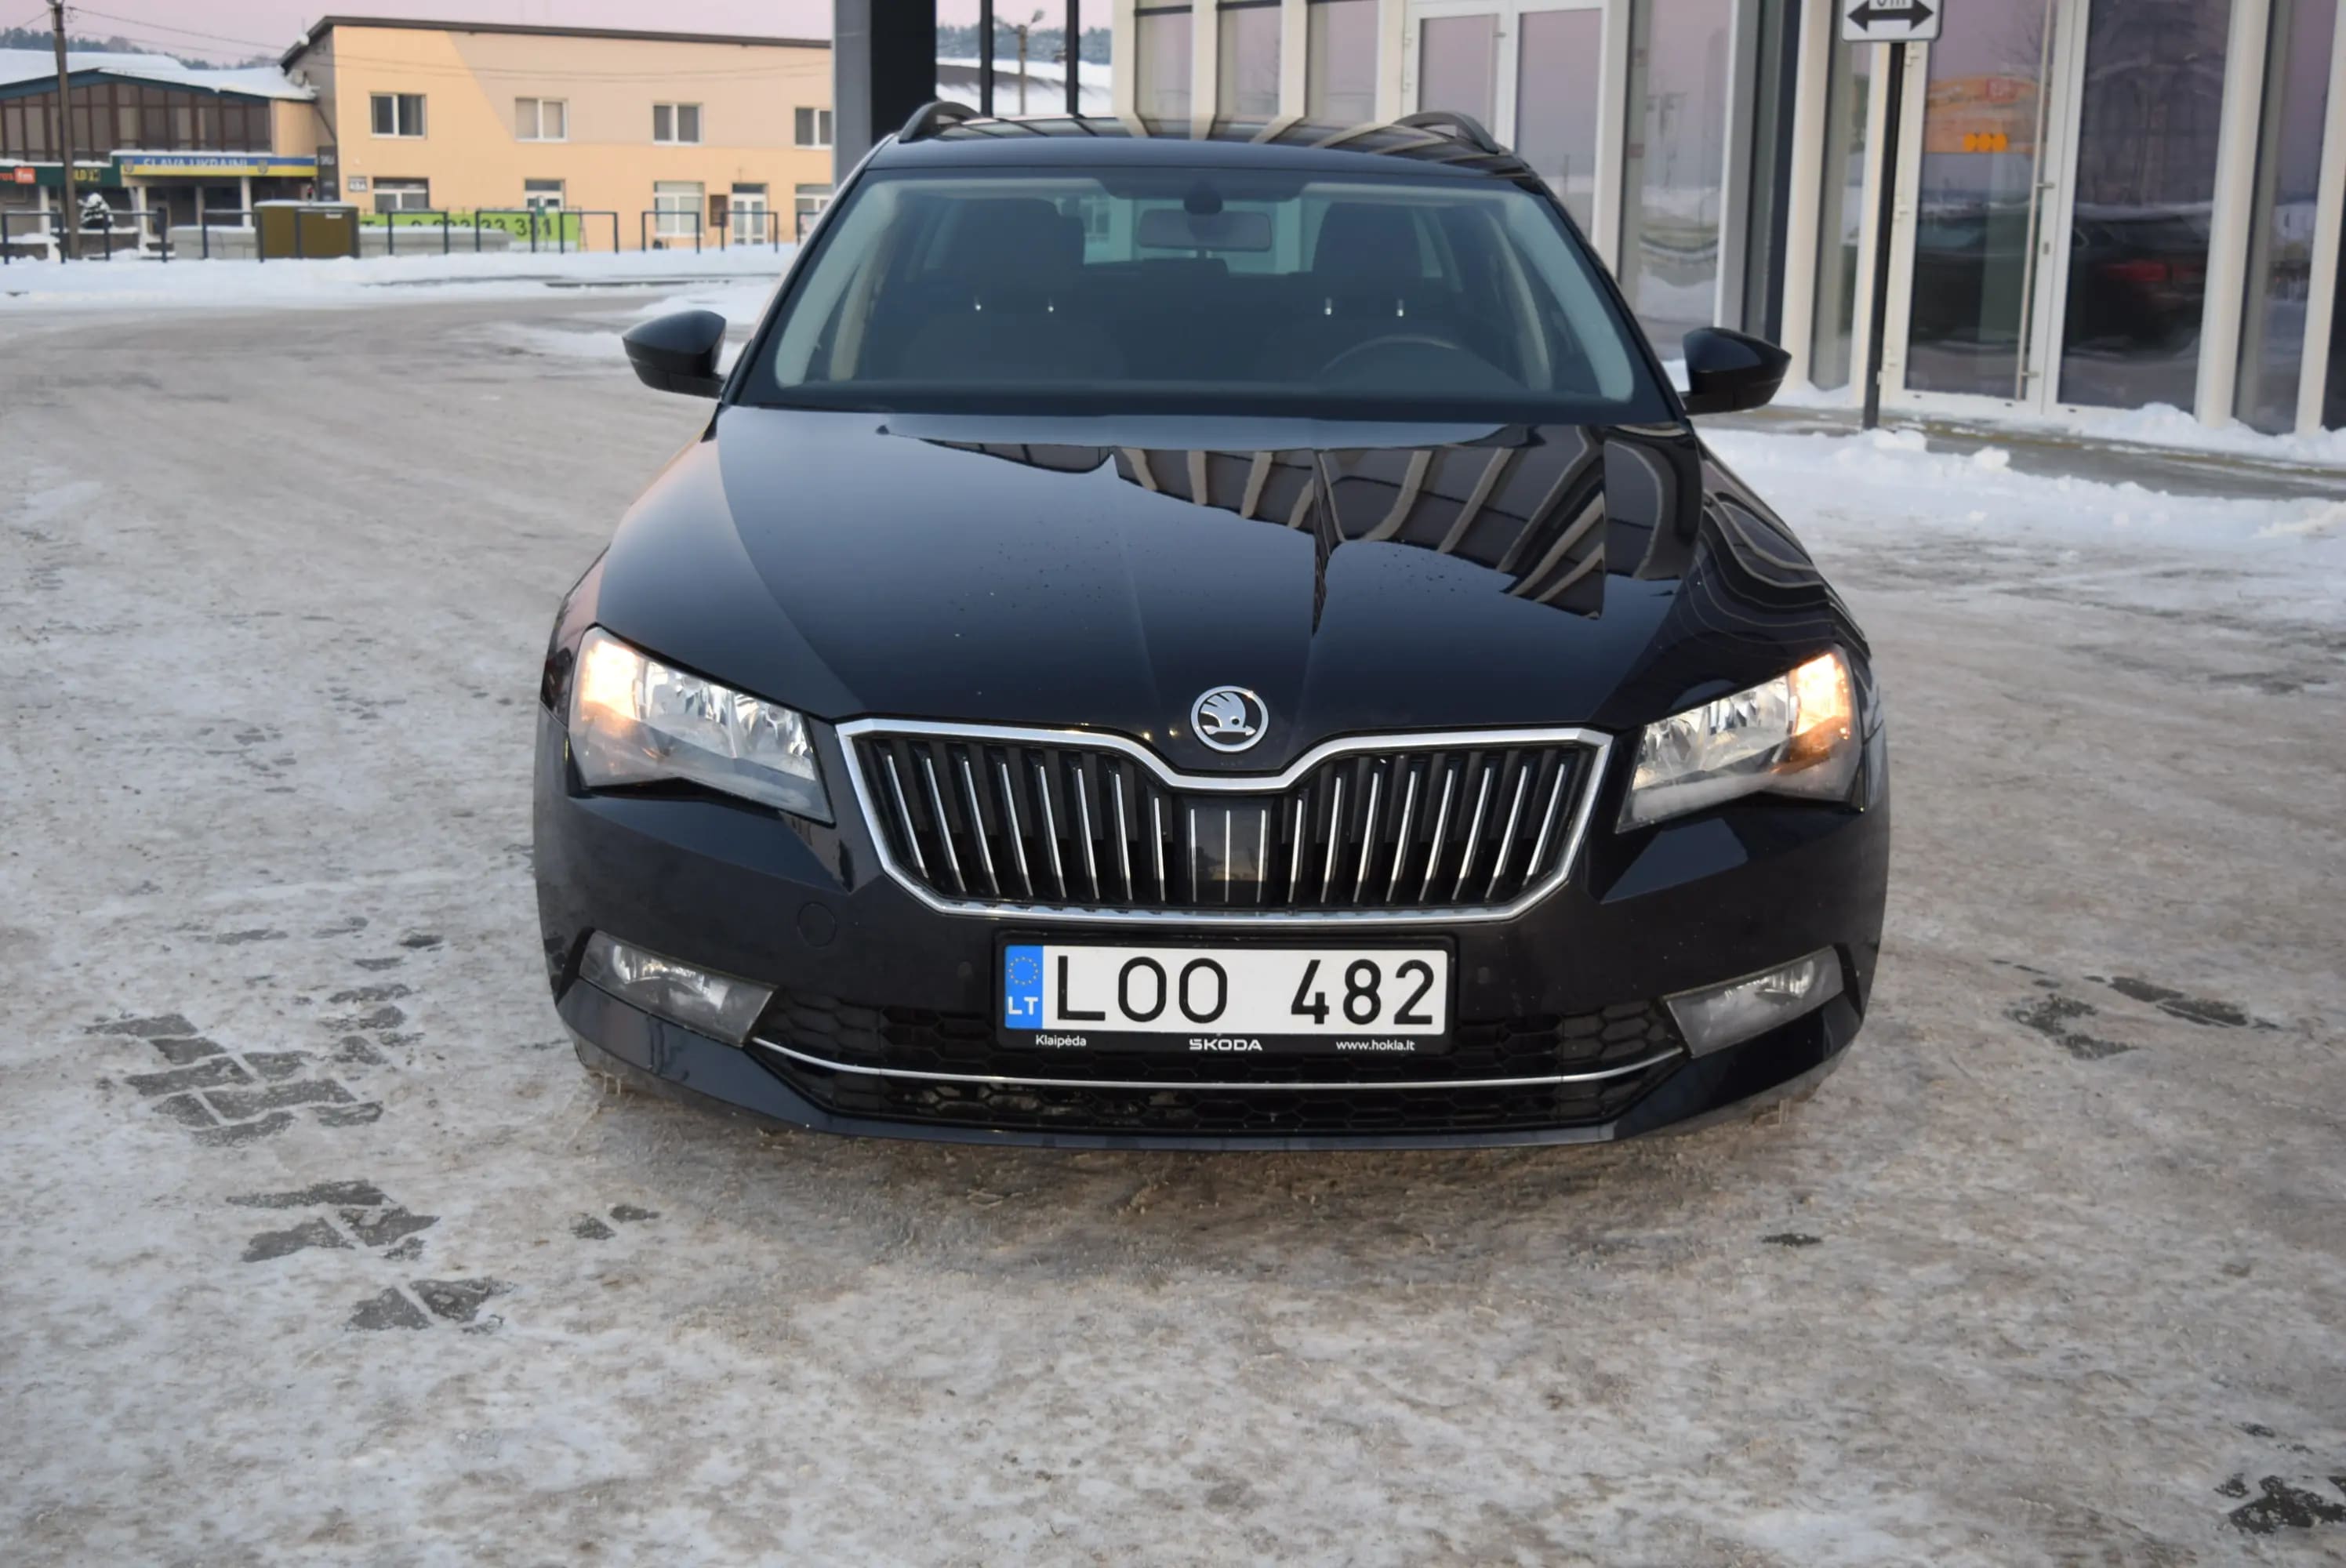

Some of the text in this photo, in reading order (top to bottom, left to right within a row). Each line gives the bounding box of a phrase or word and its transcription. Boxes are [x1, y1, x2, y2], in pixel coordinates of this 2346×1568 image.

[143, 158, 186, 169] SLAVA
[1057, 954, 1435, 1025] LOO 482
[1008, 996, 1039, 1015] LT
[1035, 1034, 1087, 1048] Klaipėda
[1335, 1040, 1415, 1051] www.hokla.lt
